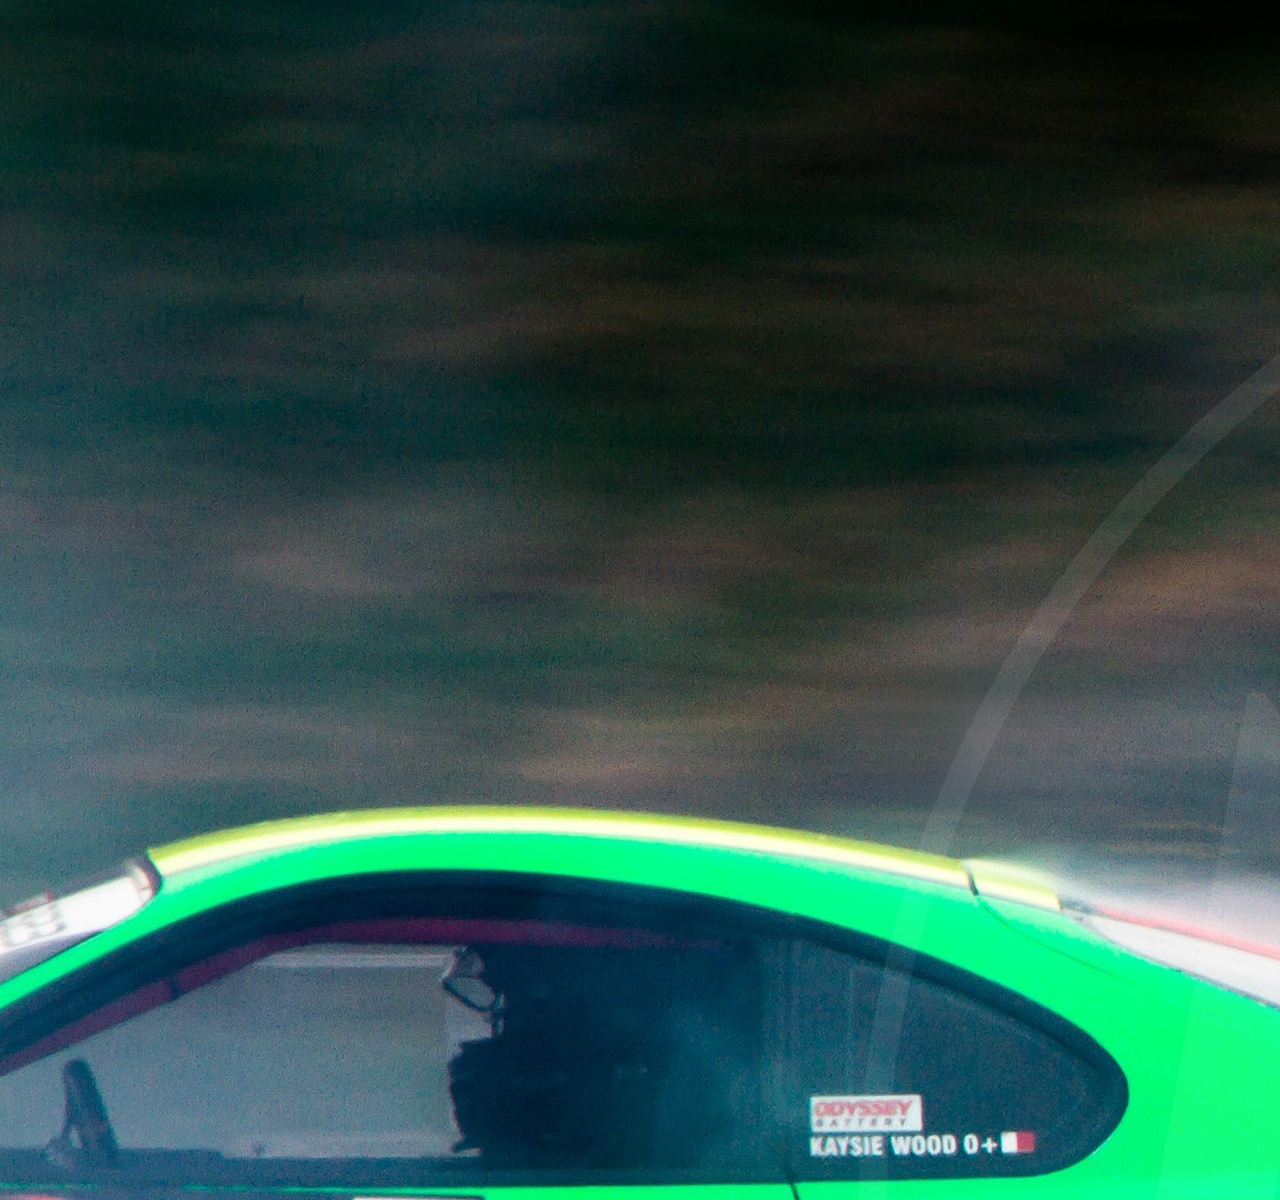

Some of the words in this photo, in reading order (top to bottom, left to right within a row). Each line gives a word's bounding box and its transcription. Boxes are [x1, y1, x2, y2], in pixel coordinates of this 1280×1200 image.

[814, 1100, 913, 1117] ODYSSEY
[816, 1118, 908, 1128] BATTERY
[810, 1135, 884, 1156] KAYSIE
[890, 1134, 957, 1157] WOOD
